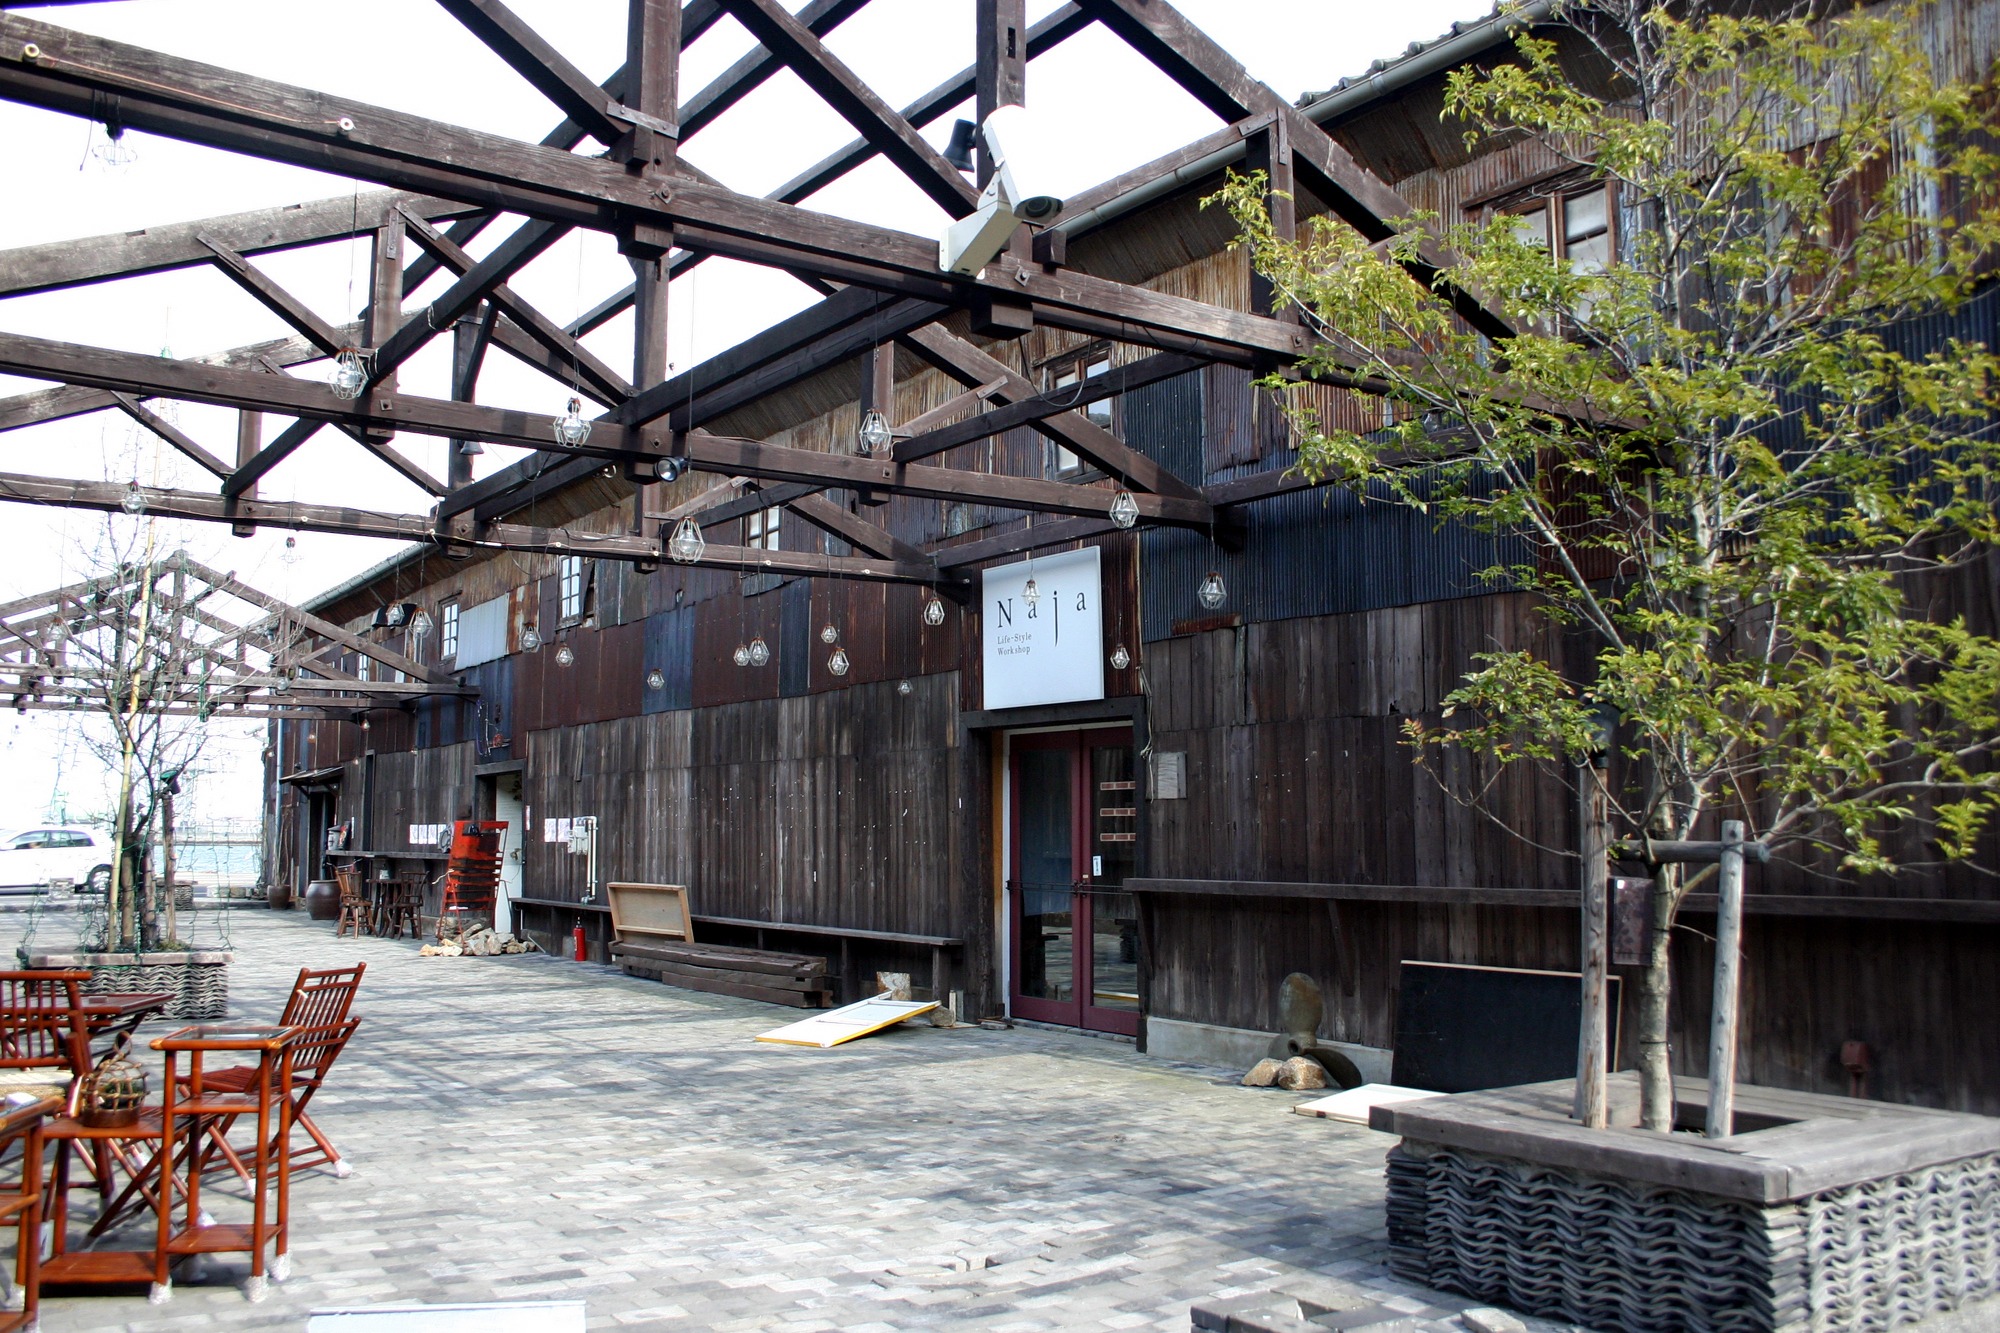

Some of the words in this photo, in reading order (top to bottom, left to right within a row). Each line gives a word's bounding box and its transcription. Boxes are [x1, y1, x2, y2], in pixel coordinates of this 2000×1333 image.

[997, 590, 1087, 647] Naja
[997, 632, 1032, 645] Life-Style
[997, 645, 1031, 656] Workshop
